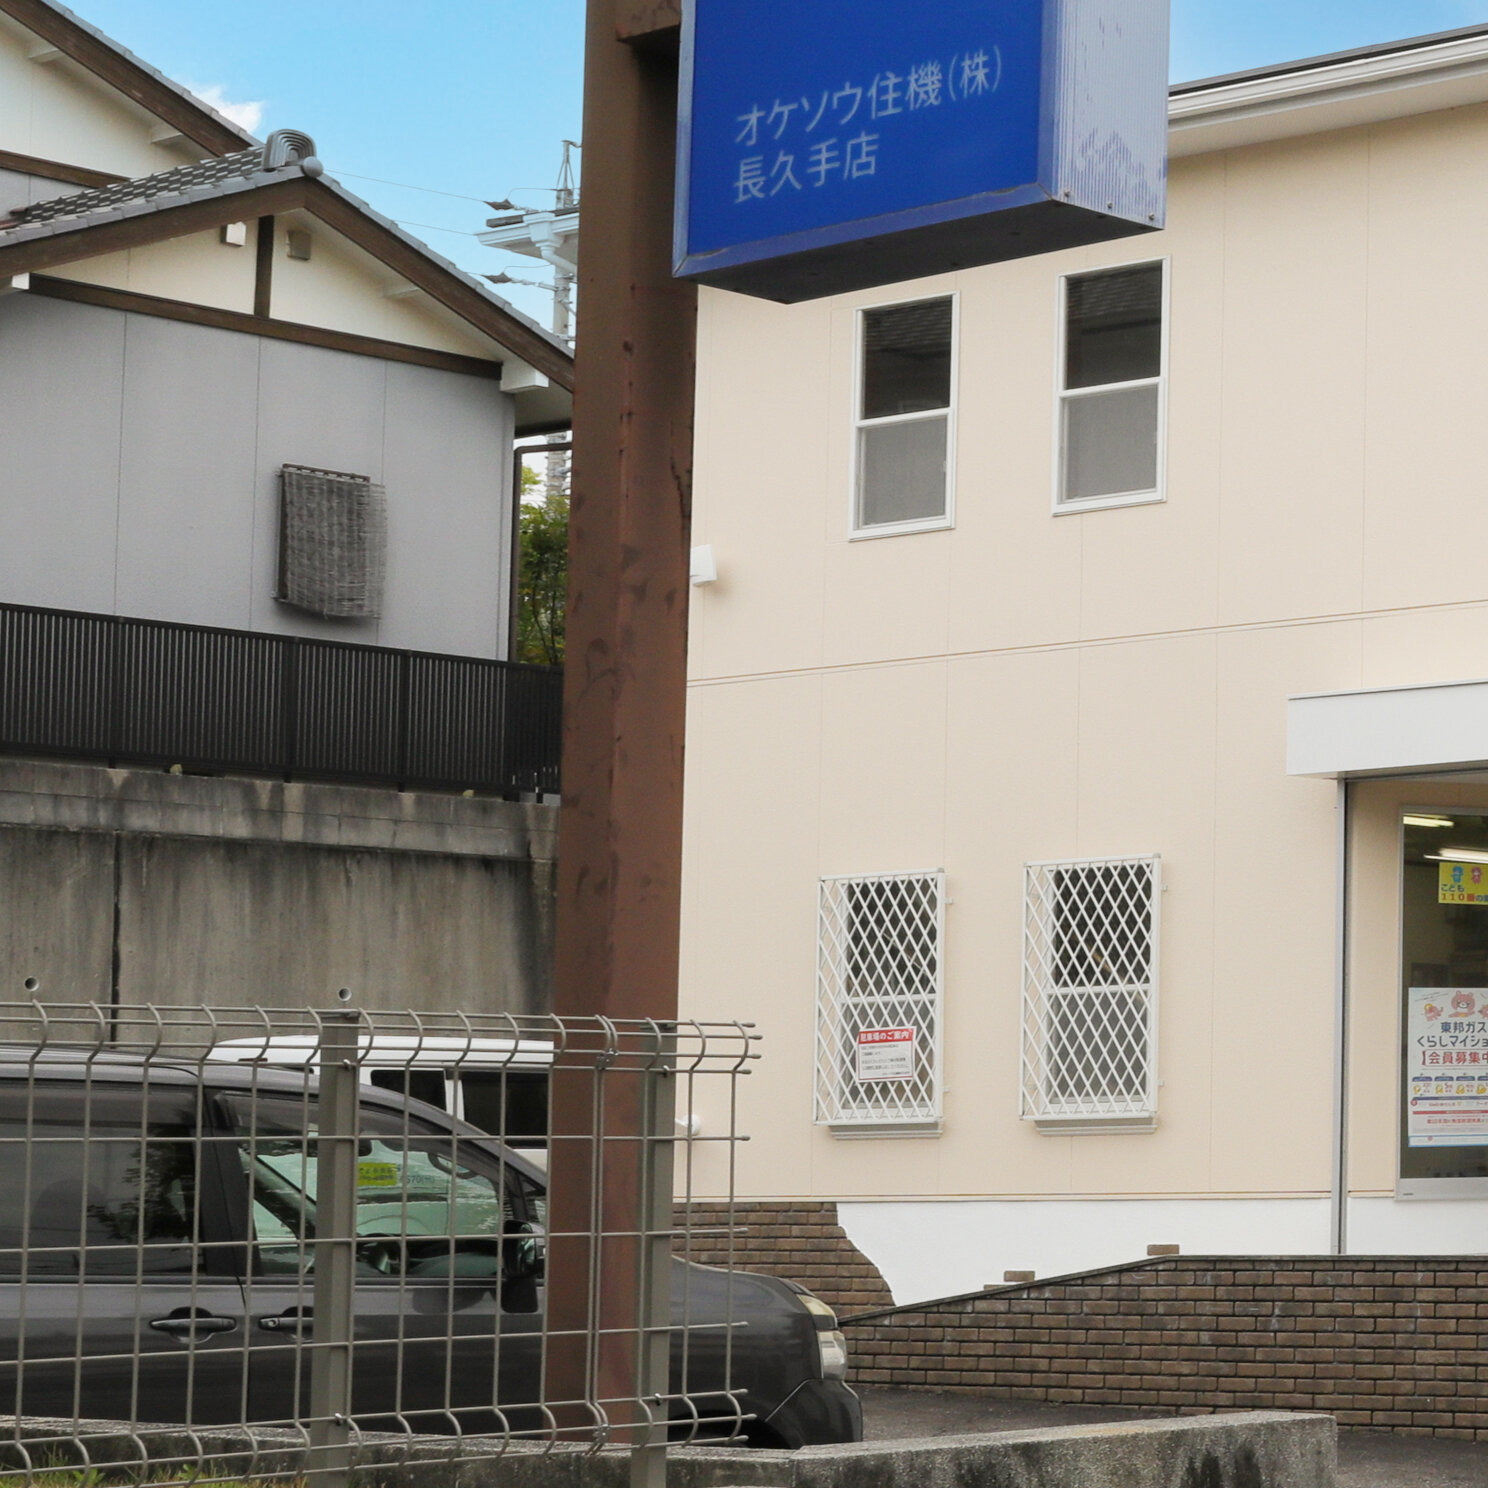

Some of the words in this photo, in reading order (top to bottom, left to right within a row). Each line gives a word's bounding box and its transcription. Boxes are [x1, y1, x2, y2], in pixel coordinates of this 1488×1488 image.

[734, 45, 1001, 148] オケソウ住機(株)
[733, 131, 880, 203] 長久手店
[1440, 1021, 1488, 1034] 東邦ガス
